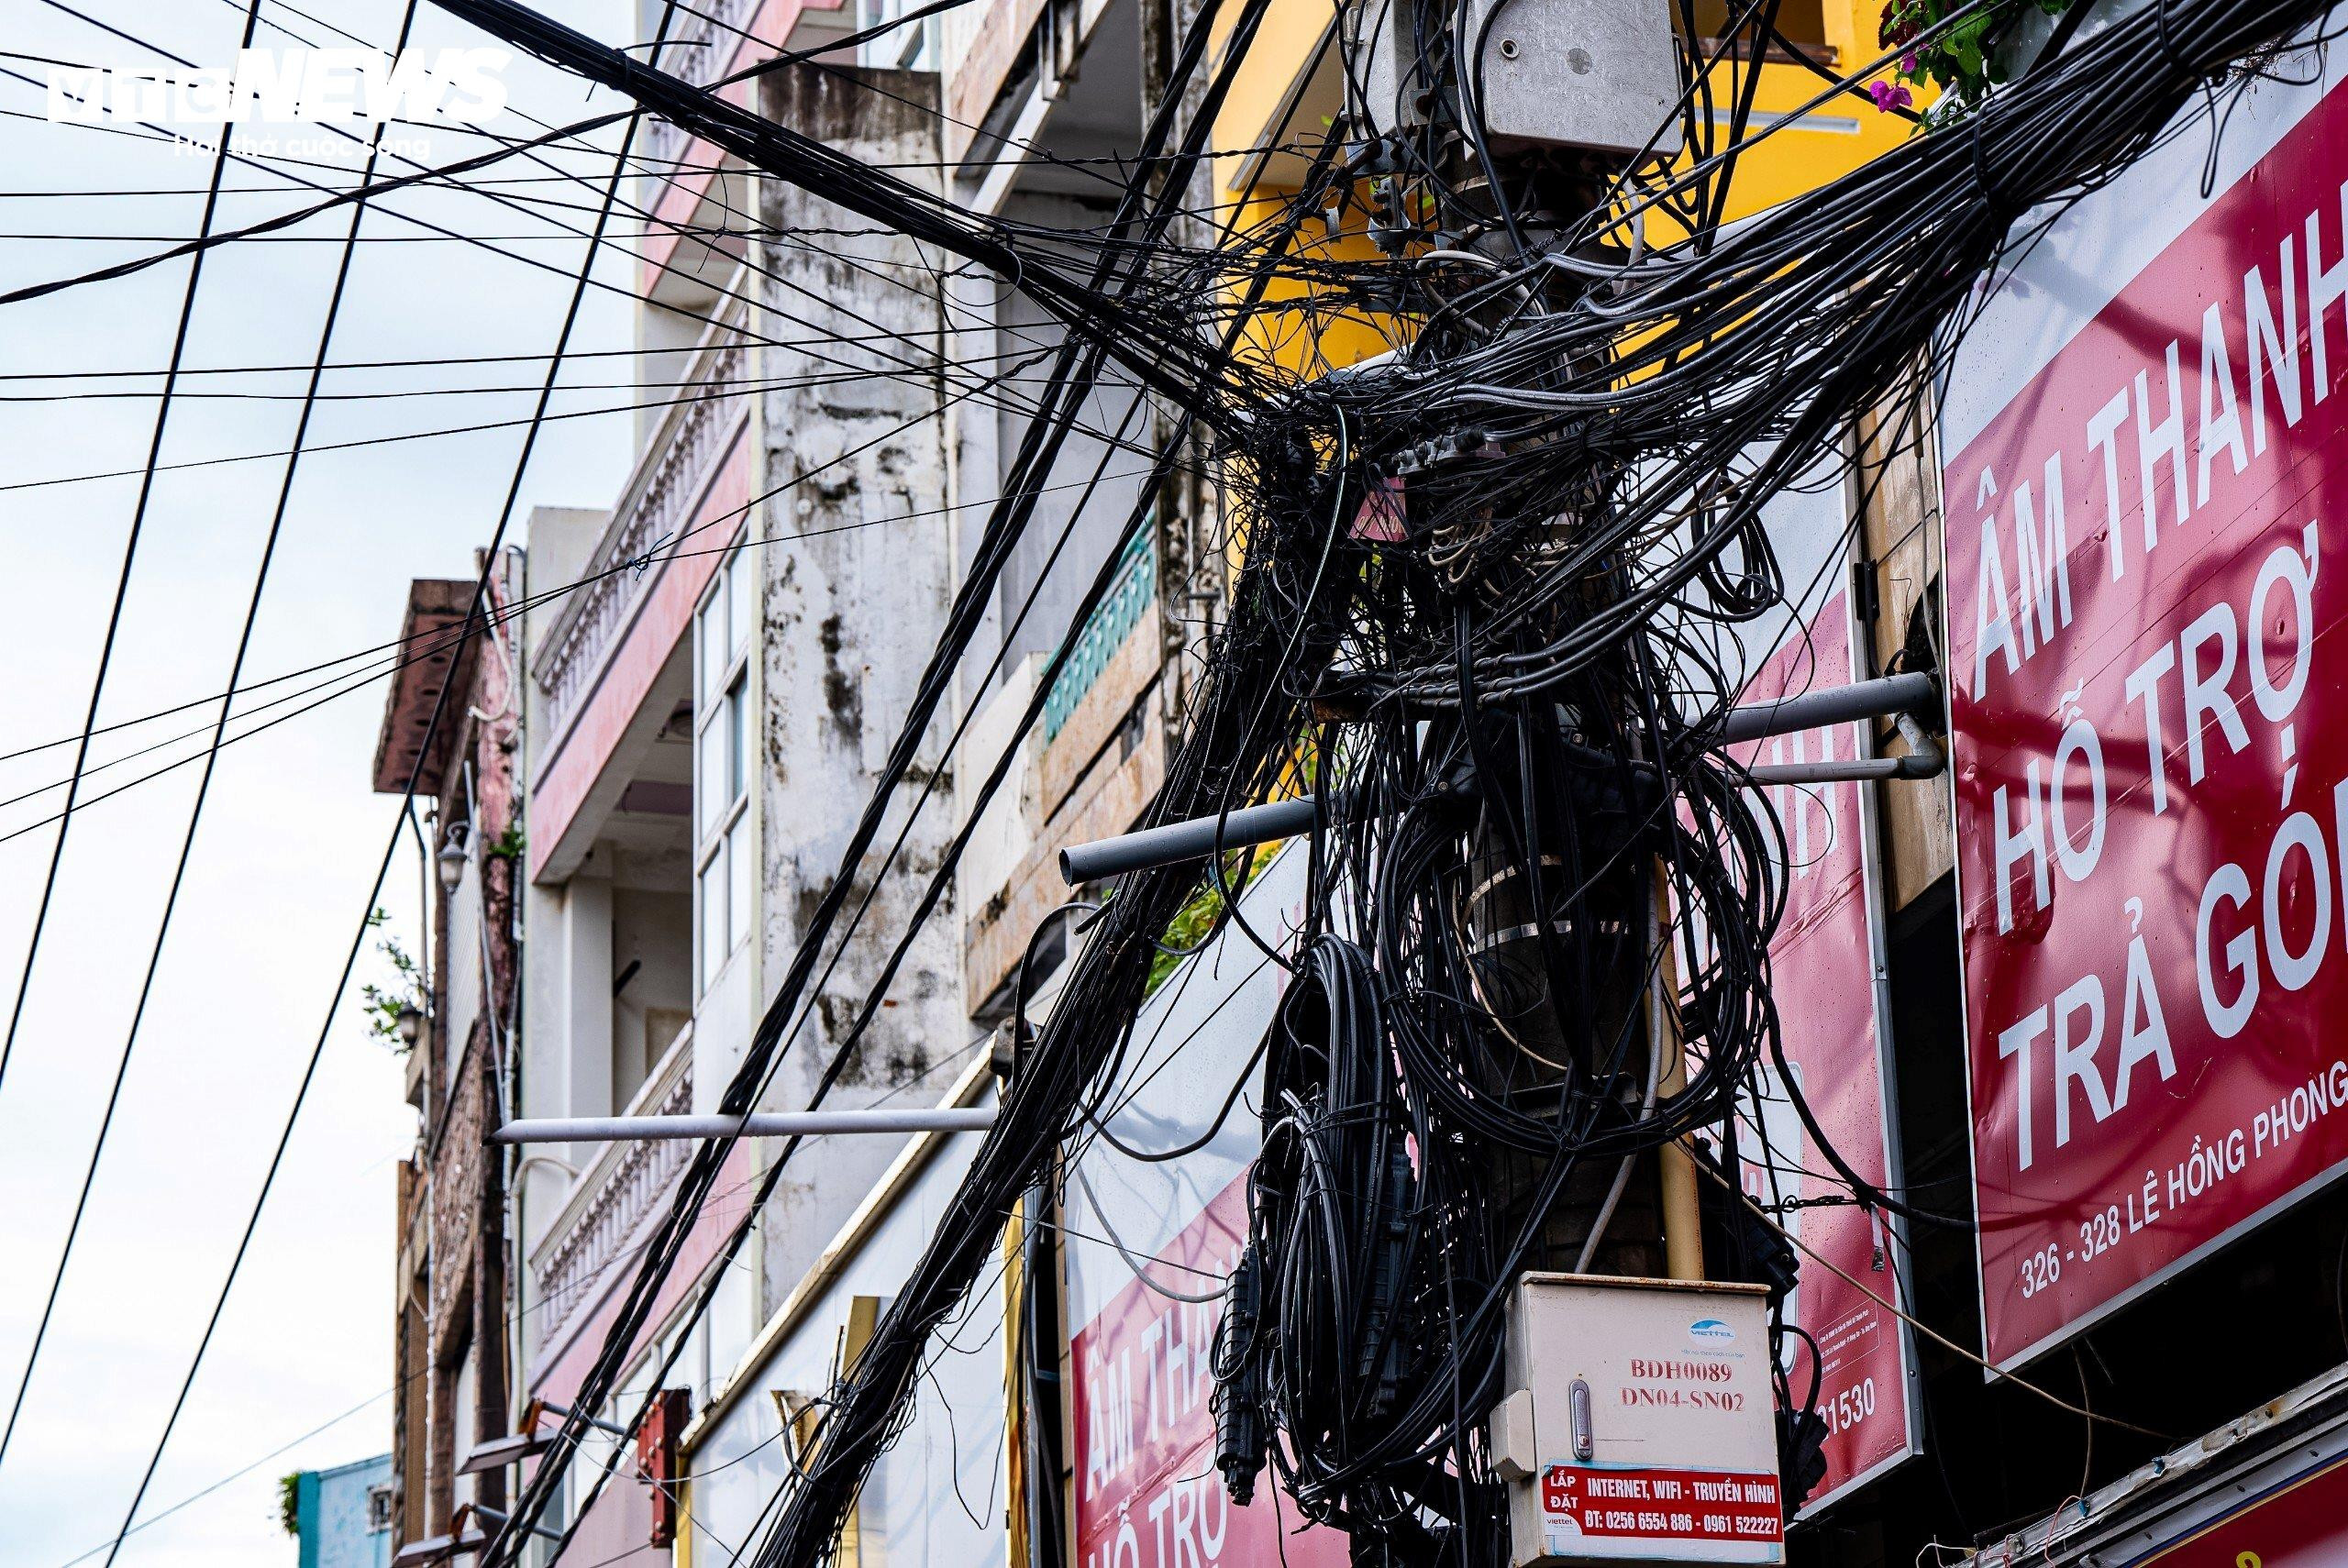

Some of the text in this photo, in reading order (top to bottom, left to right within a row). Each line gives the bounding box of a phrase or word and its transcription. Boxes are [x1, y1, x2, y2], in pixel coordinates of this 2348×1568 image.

[1975, 179, 2348, 703] ÂM THANH
[1993, 678, 2107, 936] HỖ
[2125, 519, 2320, 816] TRỢ
[1999, 896, 2177, 1172] TRẢ
[2021, 1242, 2060, 1298] 326
[2080, 1206, 2121, 1263] 328
[2127, 1170, 2161, 1234] LÊ
[2168, 1134, 2246, 1209] HỒNG
[2254, 1061, 2348, 1158] PHONG
[1086, 1235, 1250, 1502] ÂM THA
[1630, 1358, 1733, 1383] BDH0089
[1621, 1386, 1745, 1412] DN04-SN02
[1550, 1470, 1577, 1488] LẮP
[1588, 1477, 1650, 1501] INTERNET,
[1653, 1480, 1682, 1500] WIFI
[1693, 1479, 1742, 1503] TRUYỀN
[1744, 1480, 1776, 1504] HÌNH
[1550, 1494, 1578, 1512] ĐẶT
[1585, 1510, 1603, 1529] ĐT:
[1605, 1510, 1634, 1529] 0256
[1638, 1512, 1667, 1530] 6554
[1670, 1513, 1693, 1531] 886
[1703, 1515, 1732, 1532] 0961
[1735, 1516, 1778, 1535] 522227
